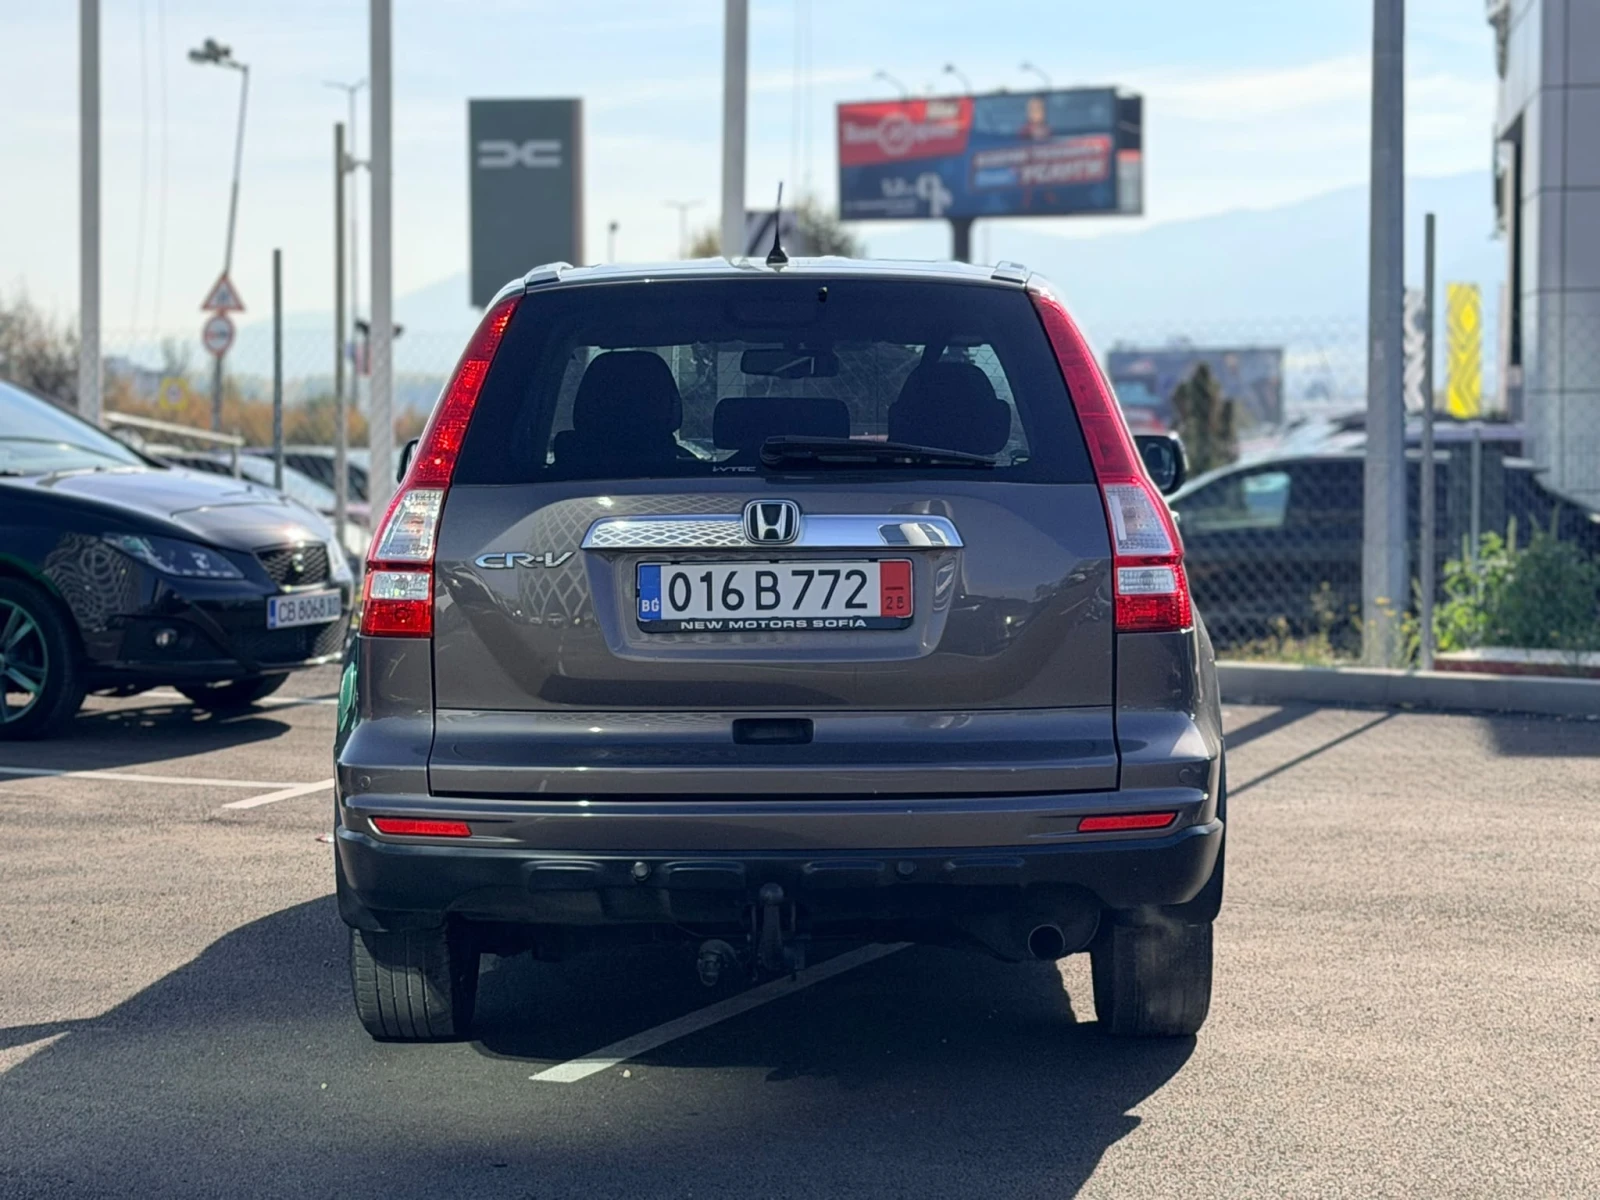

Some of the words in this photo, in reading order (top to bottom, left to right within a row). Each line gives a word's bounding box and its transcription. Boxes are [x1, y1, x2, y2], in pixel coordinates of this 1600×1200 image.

[474, 551, 576, 569] CR-V
[641, 599, 660, 612] BG
[681, 620, 723, 630] NEW
[729, 619, 808, 630] MOTORS
[812, 618, 867, 629] SOFIA
